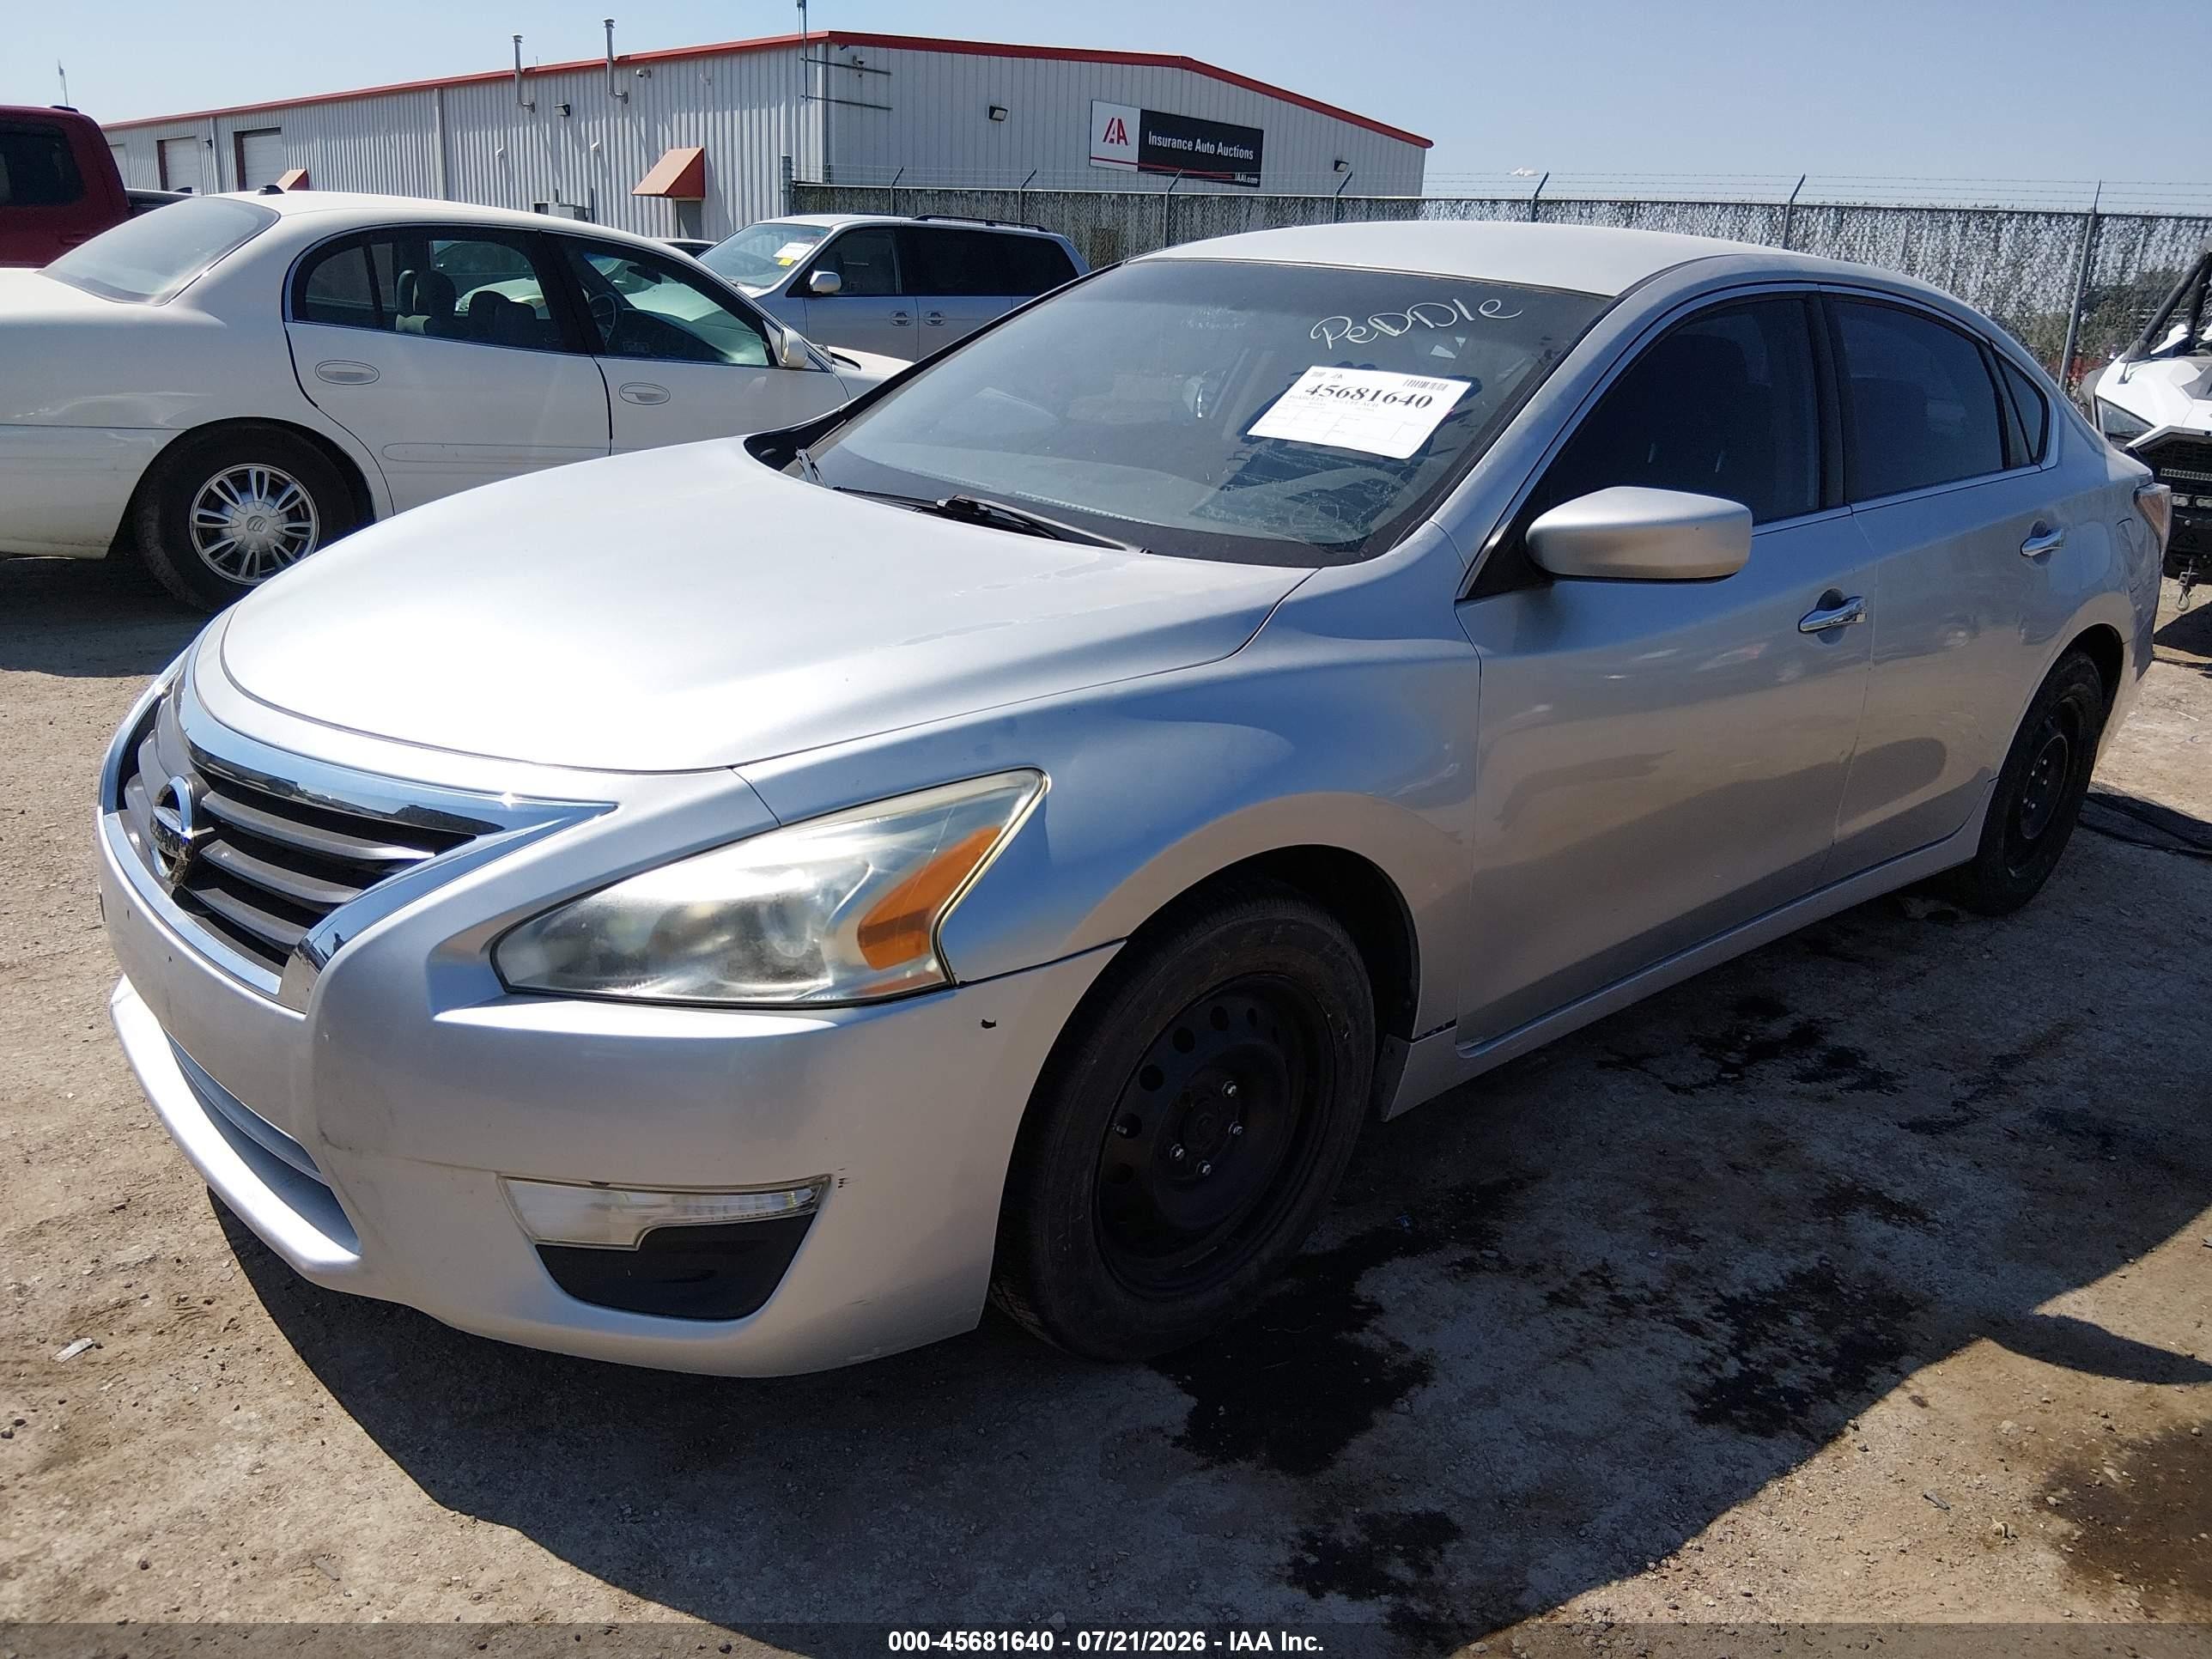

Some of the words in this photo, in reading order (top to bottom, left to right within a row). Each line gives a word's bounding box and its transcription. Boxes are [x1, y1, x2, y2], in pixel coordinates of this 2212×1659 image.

[1148, 131, 1194, 151] Insurance
[1194, 138, 1214, 155] Auto
[1216, 142, 1254, 161] Auctions
[1305, 383, 1433, 409] 45681640
